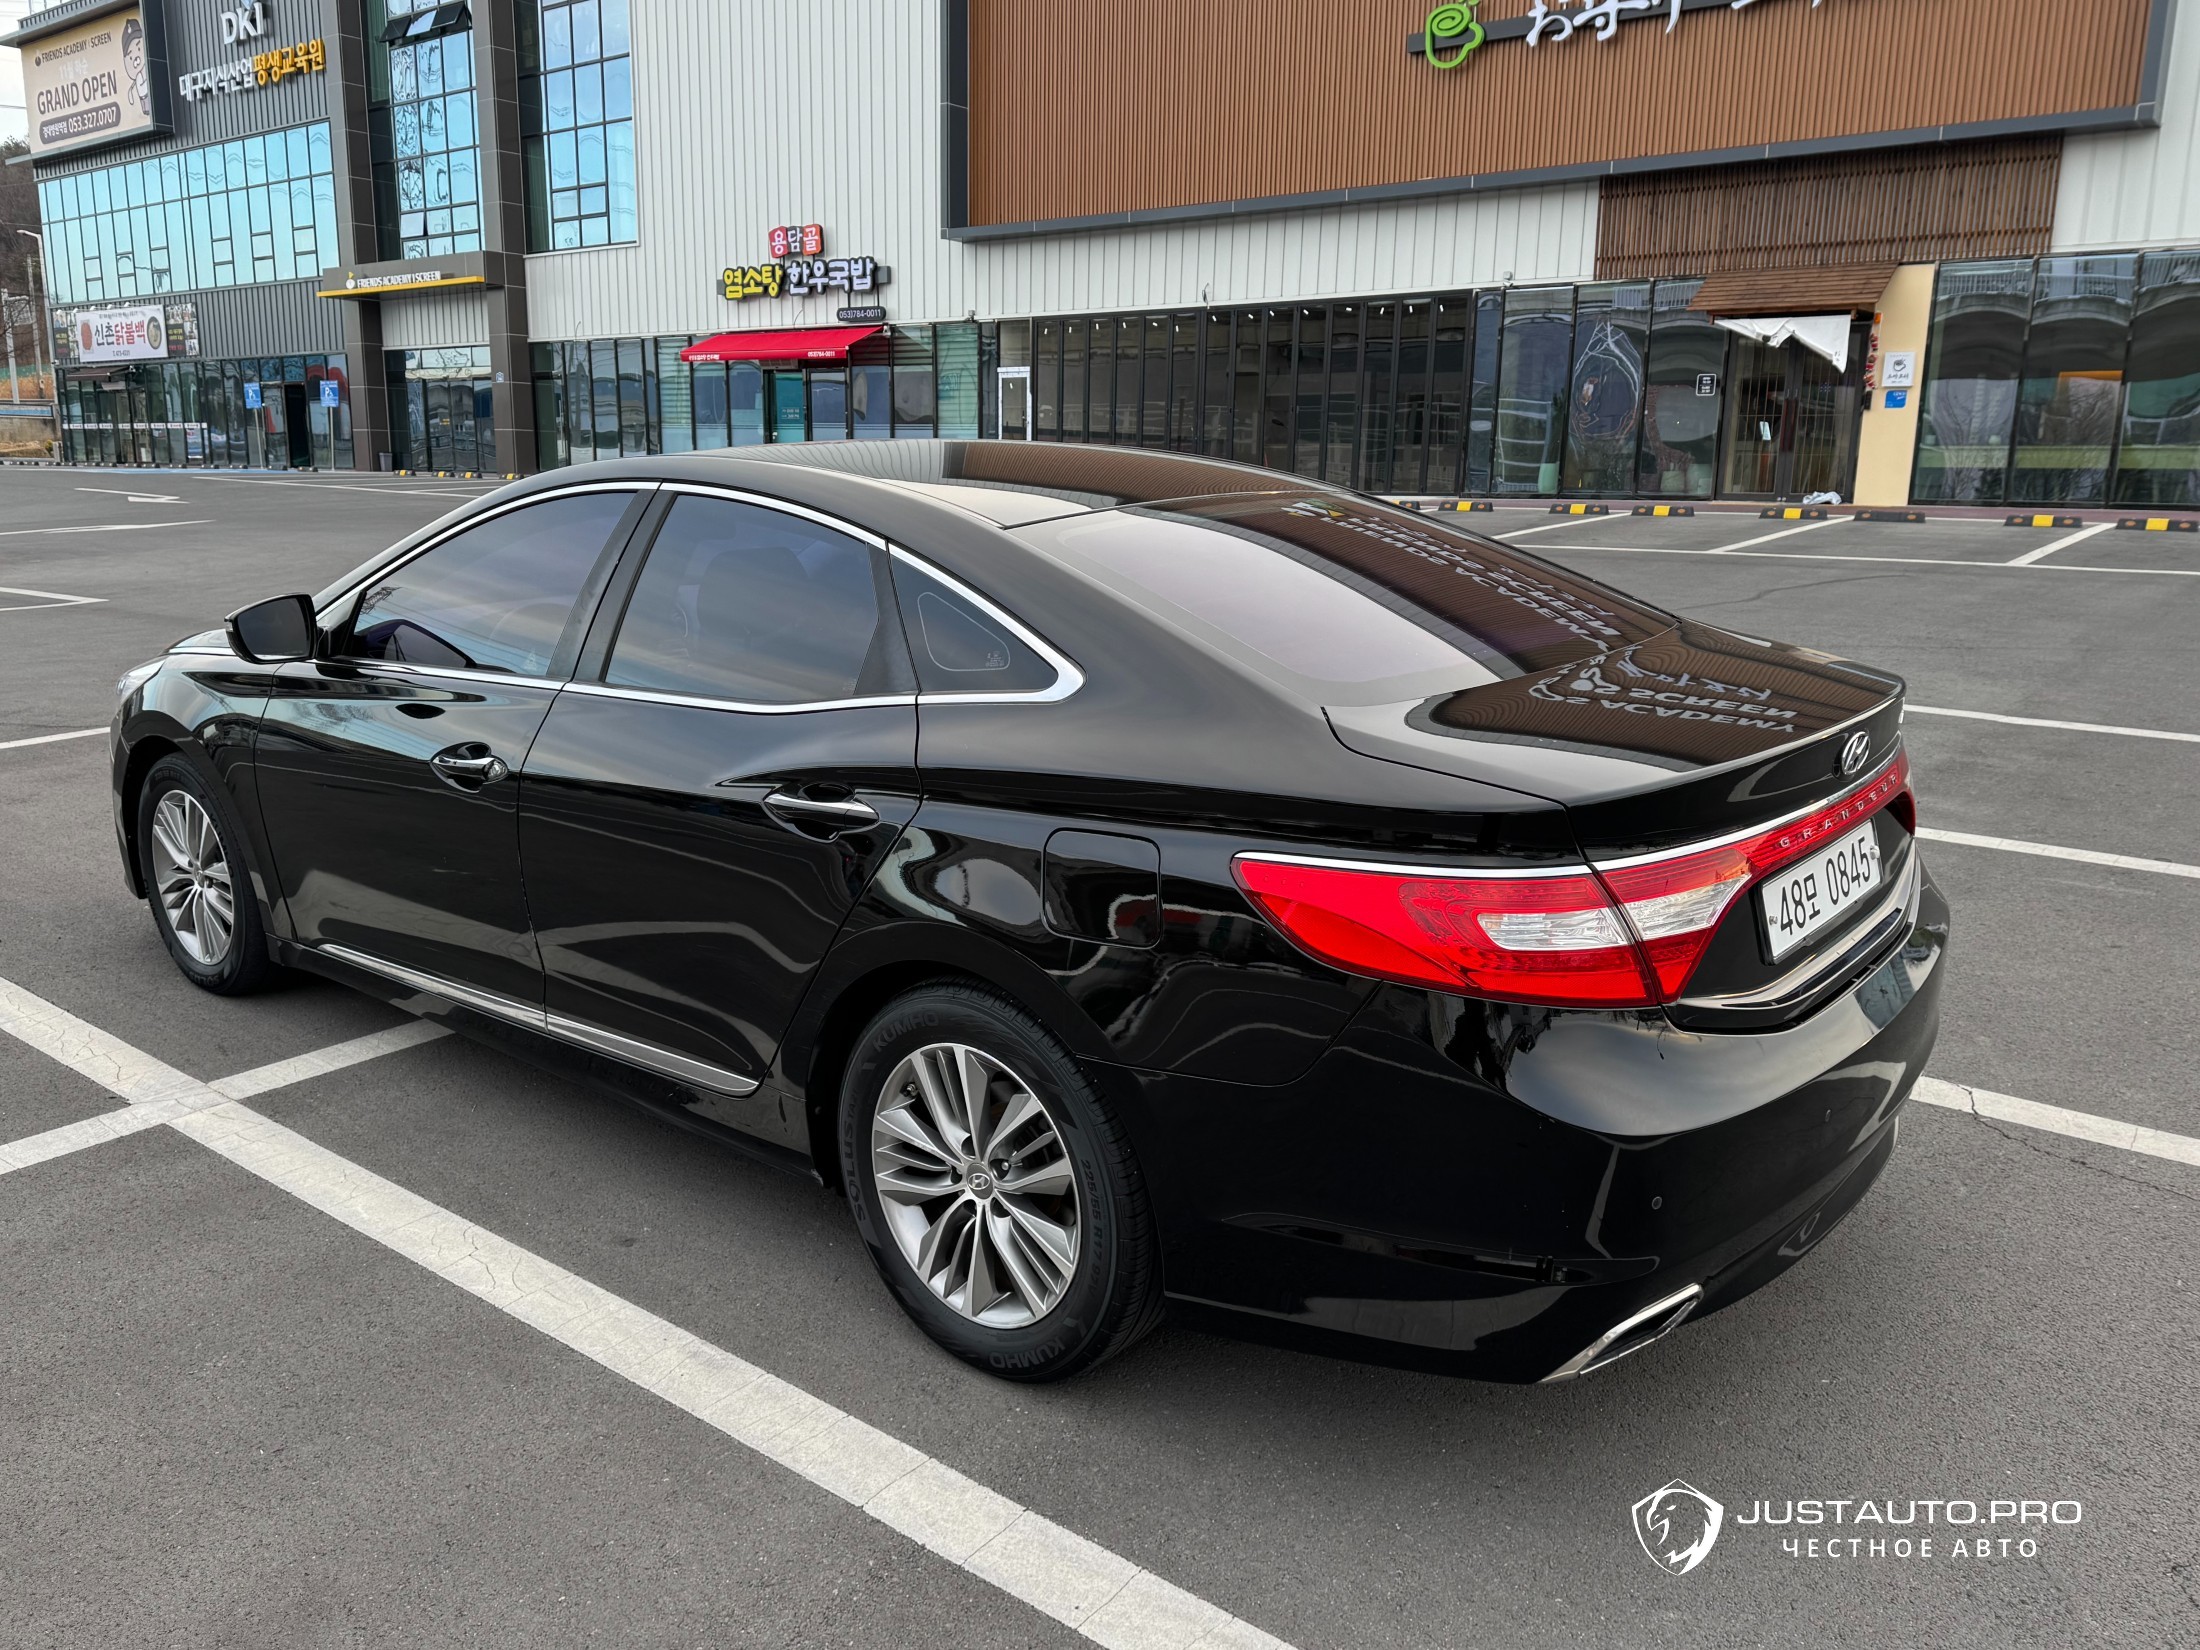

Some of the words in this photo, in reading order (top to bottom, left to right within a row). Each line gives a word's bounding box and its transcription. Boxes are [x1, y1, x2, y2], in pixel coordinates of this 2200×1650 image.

[221, 2, 264, 45] DKI
[41, 47, 63, 63] FRIENDS
[63, 39, 87, 57] ACADEMY
[90, 31, 112, 49] SCREEN
[37, 82, 80, 115] GRAND
[81, 70, 118, 103] OPEN
[68, 106, 117, 133] 053.327.0707
[771, 227, 819, 255] 용담골
[357, 276, 383, 289] FRIENDS
[383, 273, 412, 287] ACADEMY
[415, 270, 441, 283] SCREEN
[723, 263, 784, 299] 염소탕
[786, 256, 874, 296] 한우국밥
[94, 320, 146, 346] 신촌닭불백
[839, 308, 881, 319] 053)784-0011
[1780, 774, 1897, 849] GRANDEUR
[1780, 872, 1821, 936] 48모
[1825, 836, 1871, 906] 0845
[872, 1010, 940, 1053] KUMHO
[843, 1120, 867, 1222] SOLUS
[1080, 1159, 1104, 1222] 225/55
[1092, 1224, 1104, 1262] R17
[988, 1335, 1066, 1369] KUMHO
